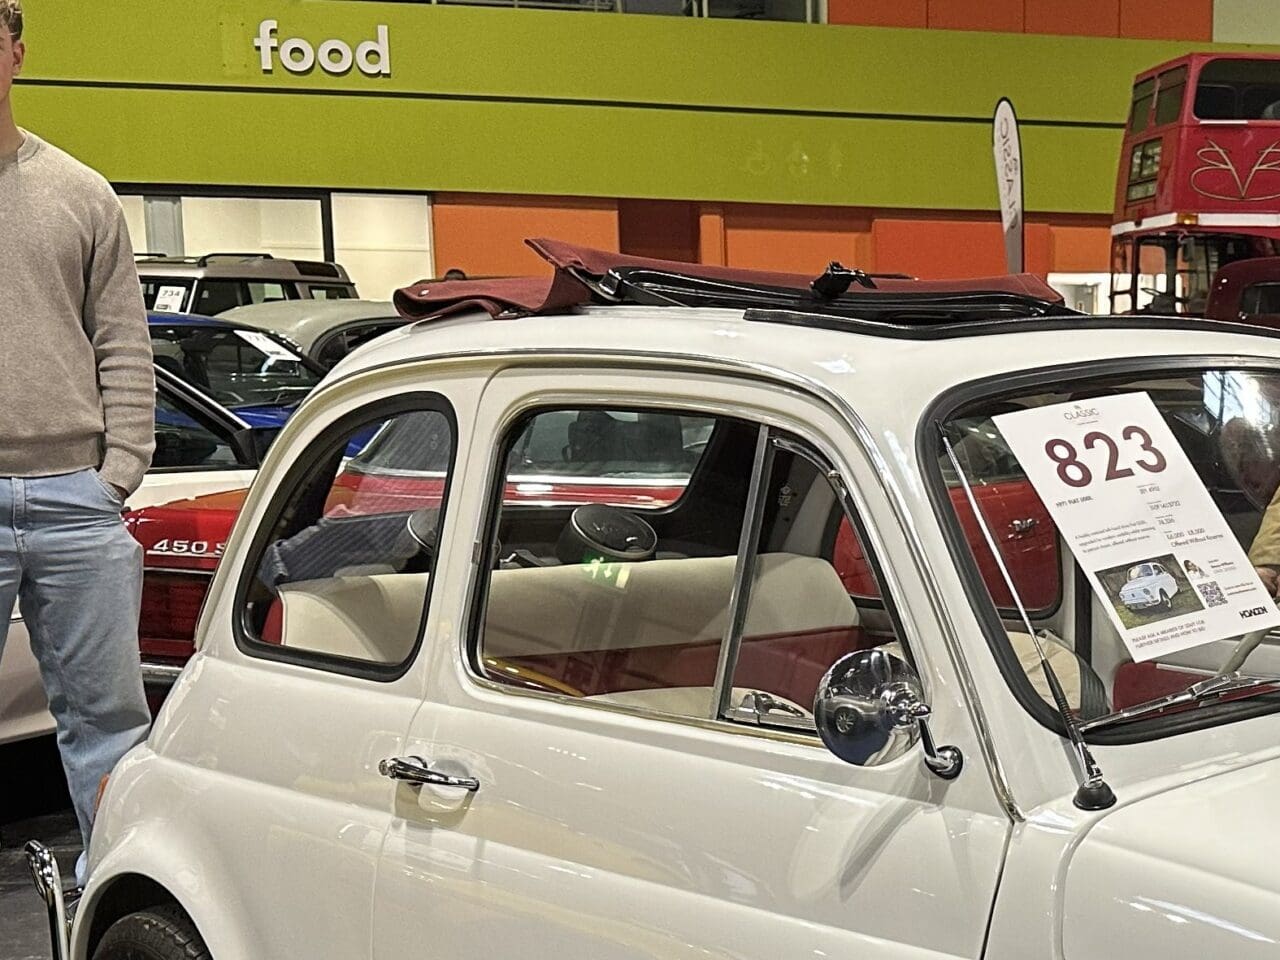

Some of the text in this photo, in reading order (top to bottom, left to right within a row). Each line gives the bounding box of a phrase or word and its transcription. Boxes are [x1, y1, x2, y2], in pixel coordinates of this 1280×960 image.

[254, 20, 391, 77] food
[1063, 408, 1099, 420] CLASSIC
[1045, 425, 1167, 487] 823
[153, 539, 208, 554] 450
